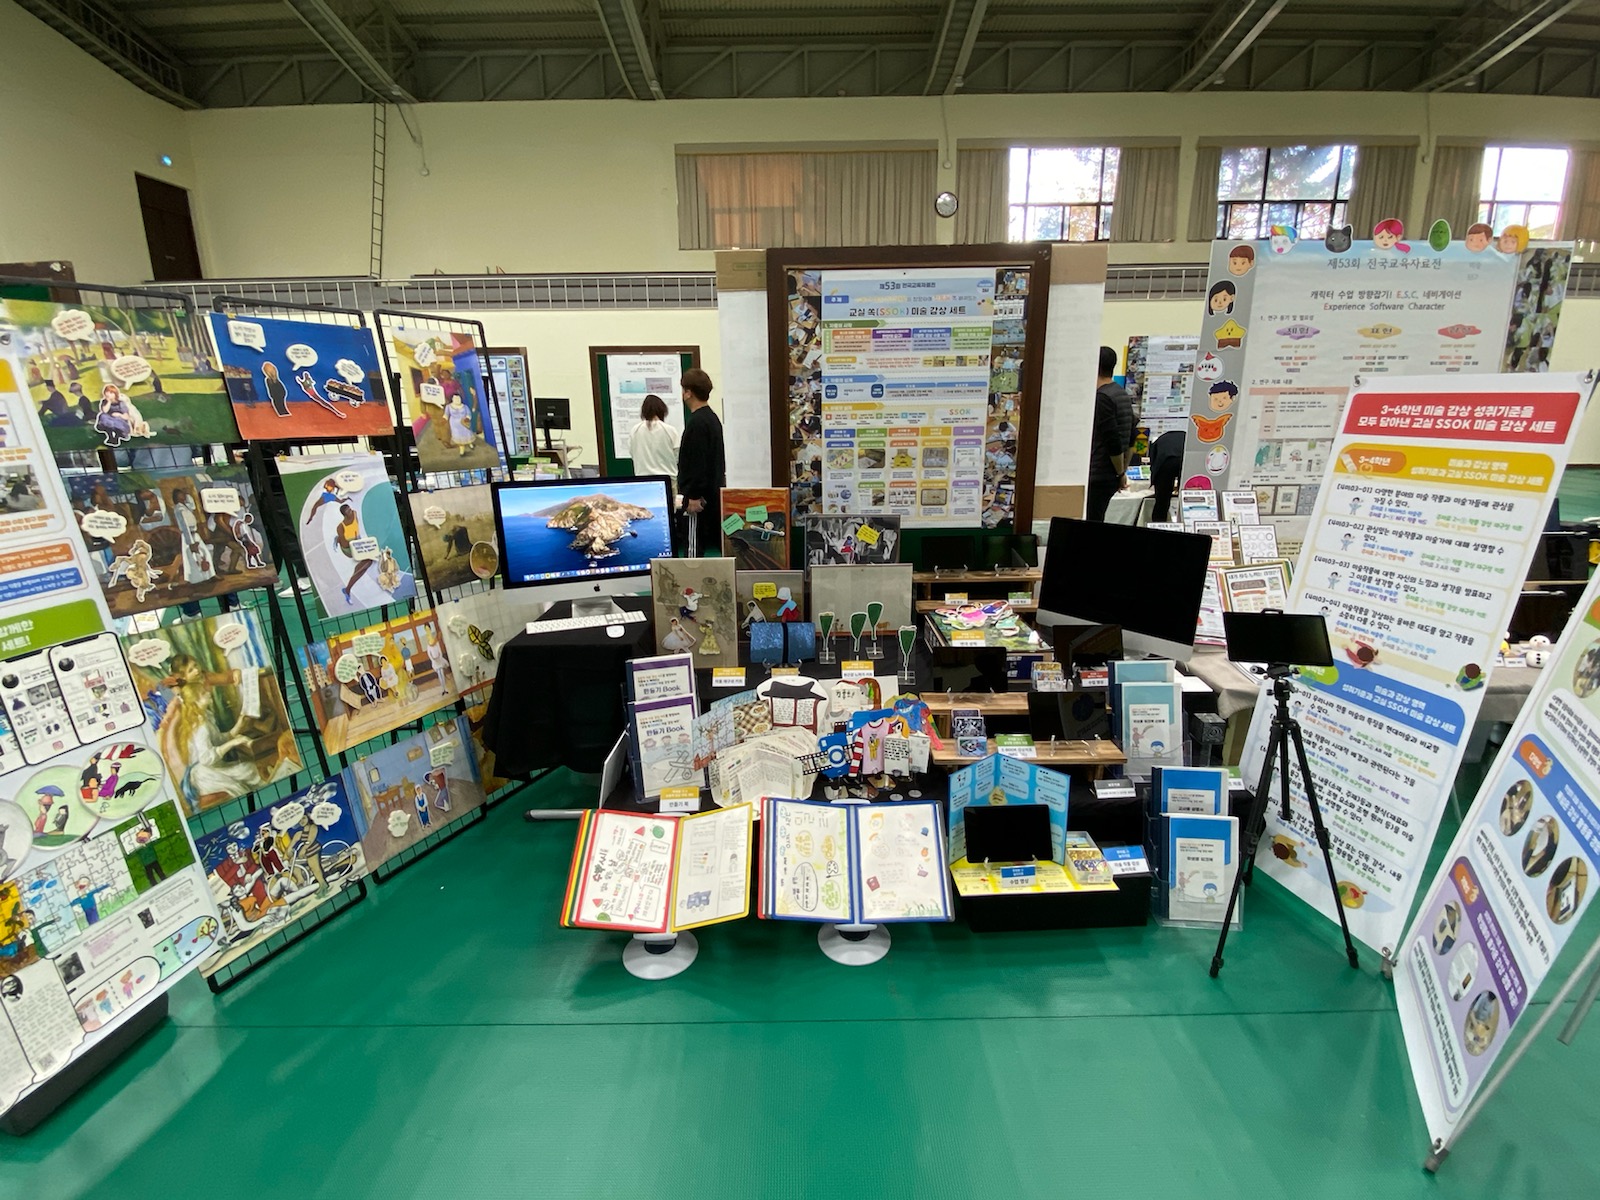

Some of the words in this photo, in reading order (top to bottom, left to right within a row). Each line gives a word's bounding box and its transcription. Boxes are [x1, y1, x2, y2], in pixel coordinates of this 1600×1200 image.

[1327, 258, 1360, 270] 제53회
[1368, 258, 1441, 269] 전국교육자료전
[1310, 291, 1334, 299] 캐릭터
[1338, 291, 1353, 299] 수업
[1423, 290, 1462, 299] 네비게이션
[850, 308, 866, 316] 교실
[911, 307, 927, 316] 미술
[930, 306, 947, 315] 감상
[949, 306, 966, 315] 세트
[1324, 303, 1365, 311] Experience
[1423, 405, 1445, 416] 미술
[1447, 405, 1471, 417] 감상
[1474, 406, 1533, 418] 성취기준을
[1358, 416, 1377, 426] 모두
[1379, 417, 1410, 428] 담아낸
[1412, 417, 1434, 428] 교실
[1435, 418, 1471, 429] SSOK
[1473, 419, 1497, 431] 미술
[1500, 420, 1527, 432] 감상
[1529, 421, 1556, 433] 세트
[1463, 471, 1488, 480] SSOK
[1416, 493, 1429, 501] 미술
[1497, 547, 1504, 555] 수
[1395, 693, 1411, 704] 감상
[1387, 701, 1409, 714] SSOK
[1424, 715, 1441, 727] 감상
